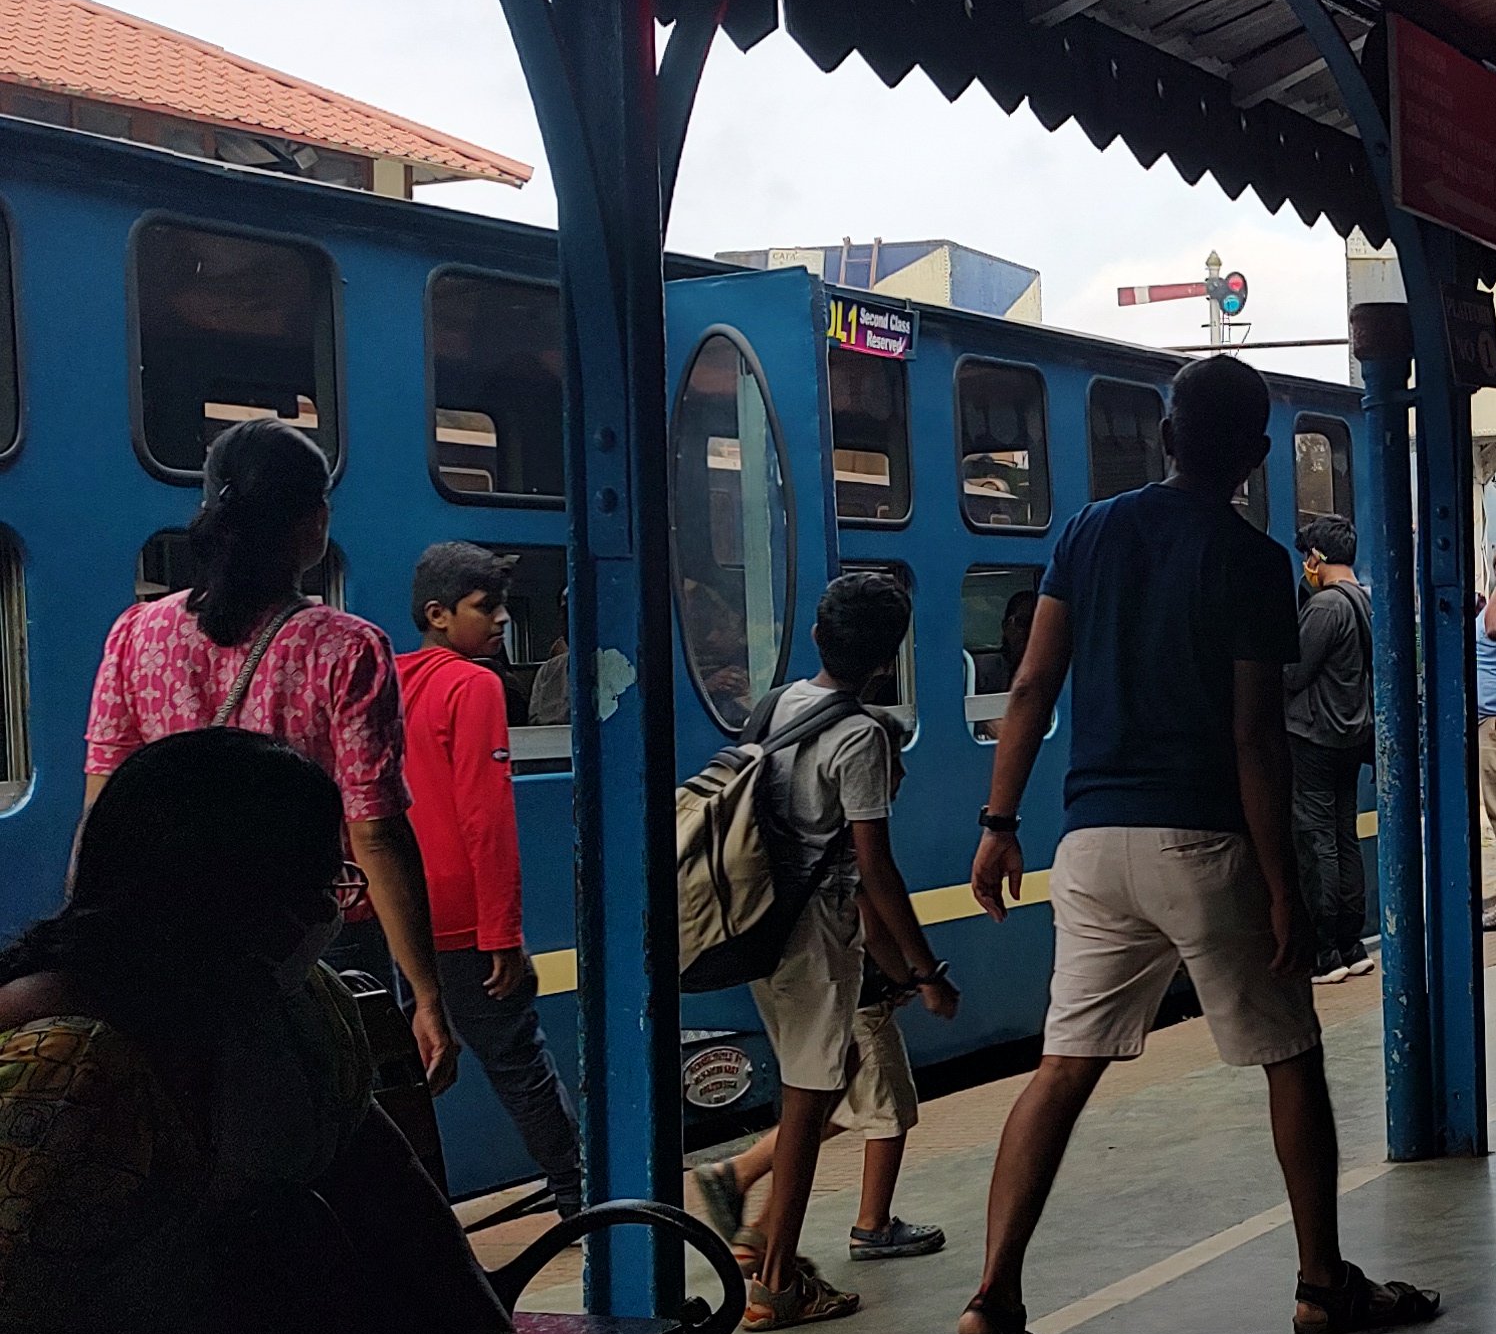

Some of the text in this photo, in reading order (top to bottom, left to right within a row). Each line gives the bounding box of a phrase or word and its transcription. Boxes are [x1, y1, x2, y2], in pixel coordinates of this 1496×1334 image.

[860, 307, 889, 330] Second
[890, 314, 911, 335] Class
[866, 330, 903, 354] Reserved
